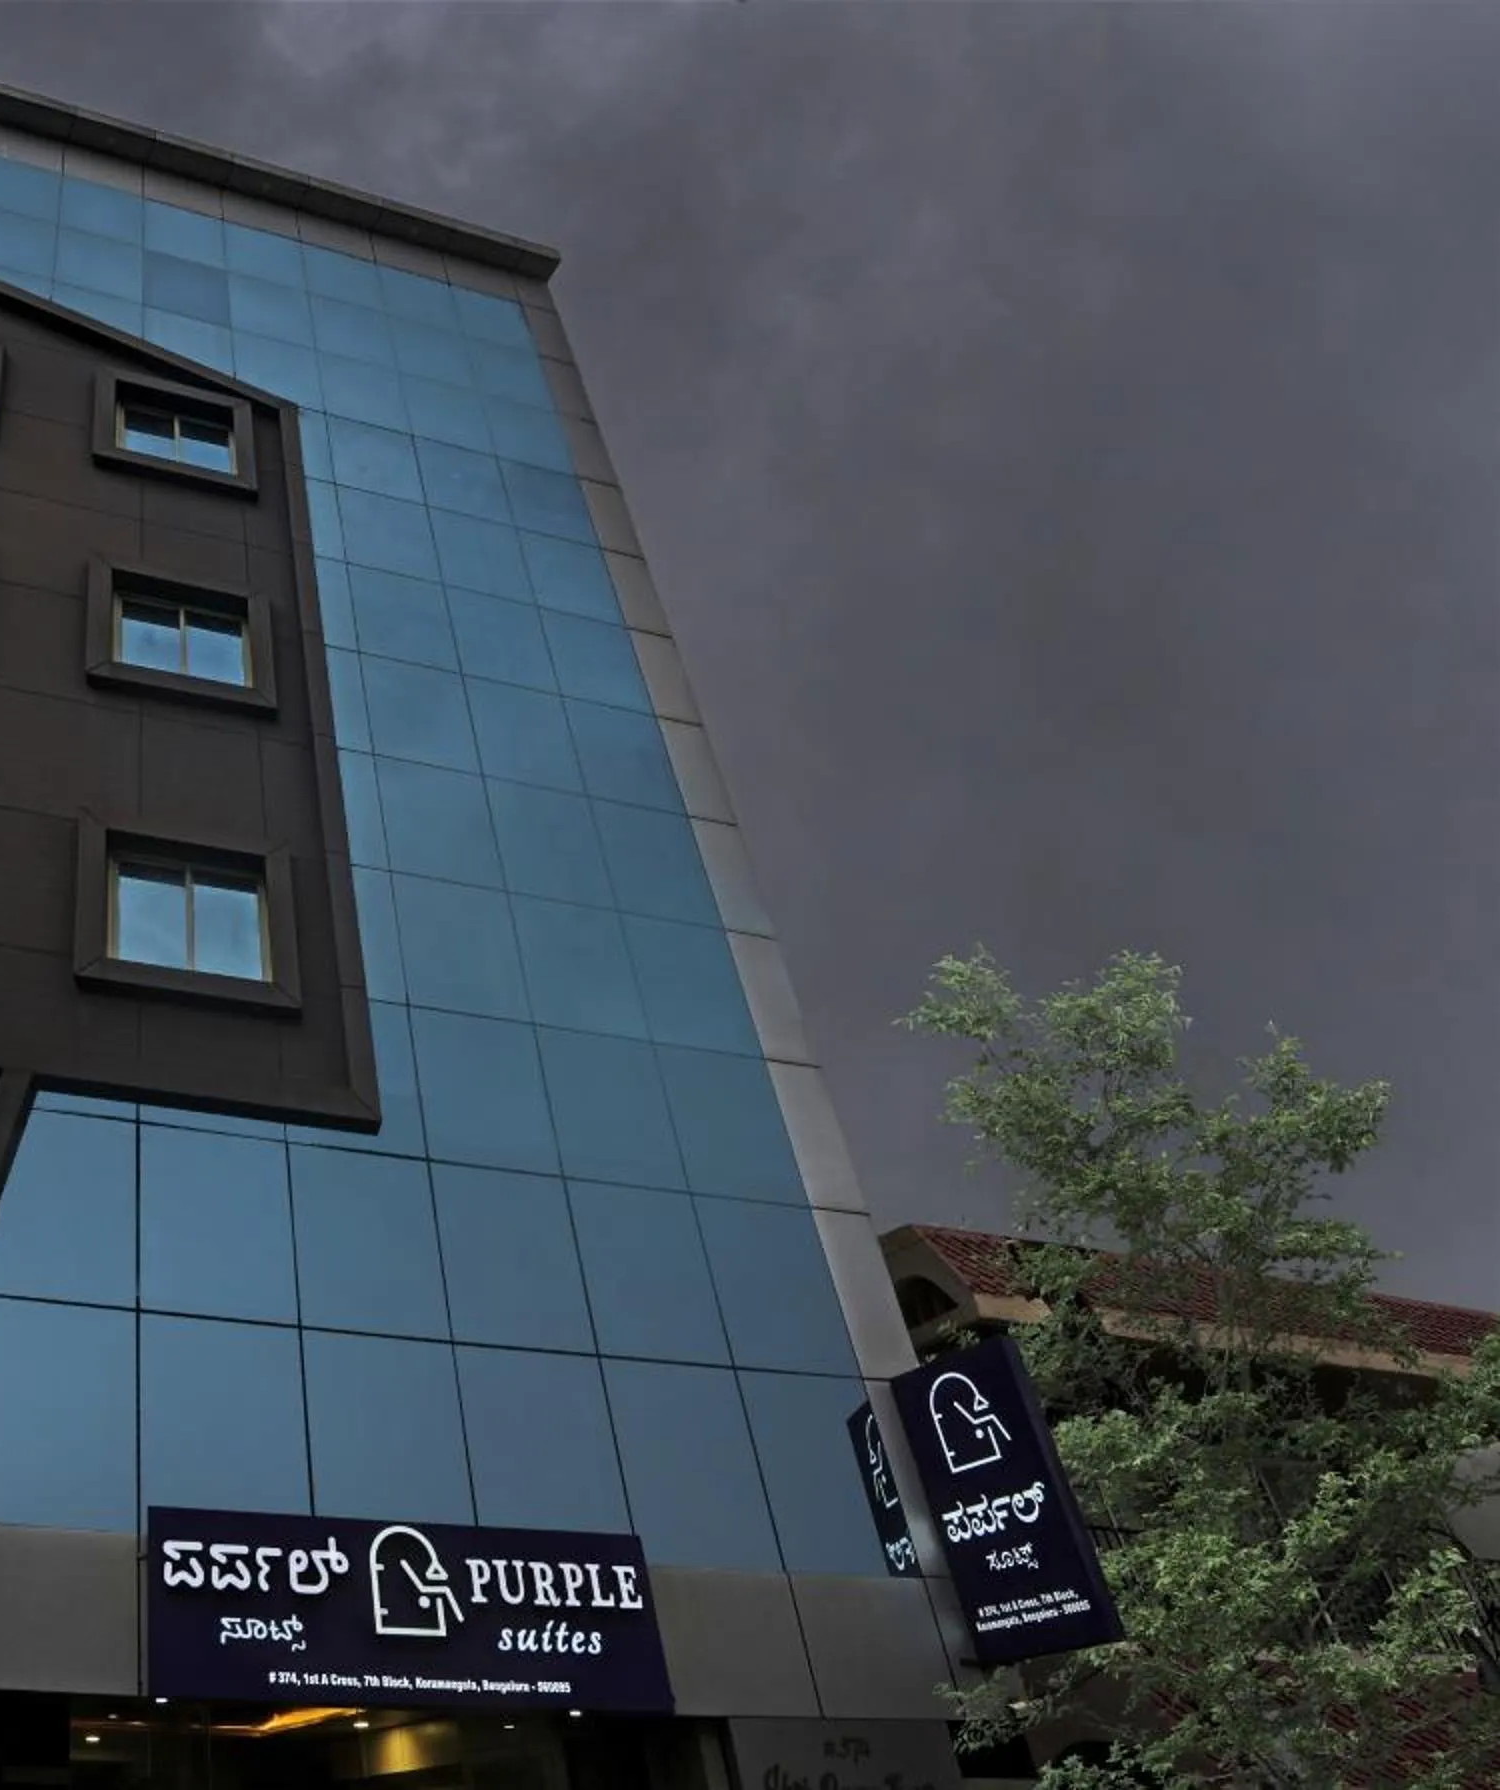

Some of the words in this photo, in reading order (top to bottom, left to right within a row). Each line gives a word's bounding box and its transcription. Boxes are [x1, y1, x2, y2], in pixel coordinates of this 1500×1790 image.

[464, 1556, 644, 1610] PURPLE
[497, 1619, 602, 1655] suites
[278, 1671, 301, 1687] 374,
[303, 1672, 320, 1685] 1st
[320, 1672, 329, 1686] A
[329, 1672, 362, 1688] Cross,
[363, 1674, 381, 1687] 7th
[381, 1675, 413, 1690] Block,
[415, 1676, 481, 1693] Koramangala,
